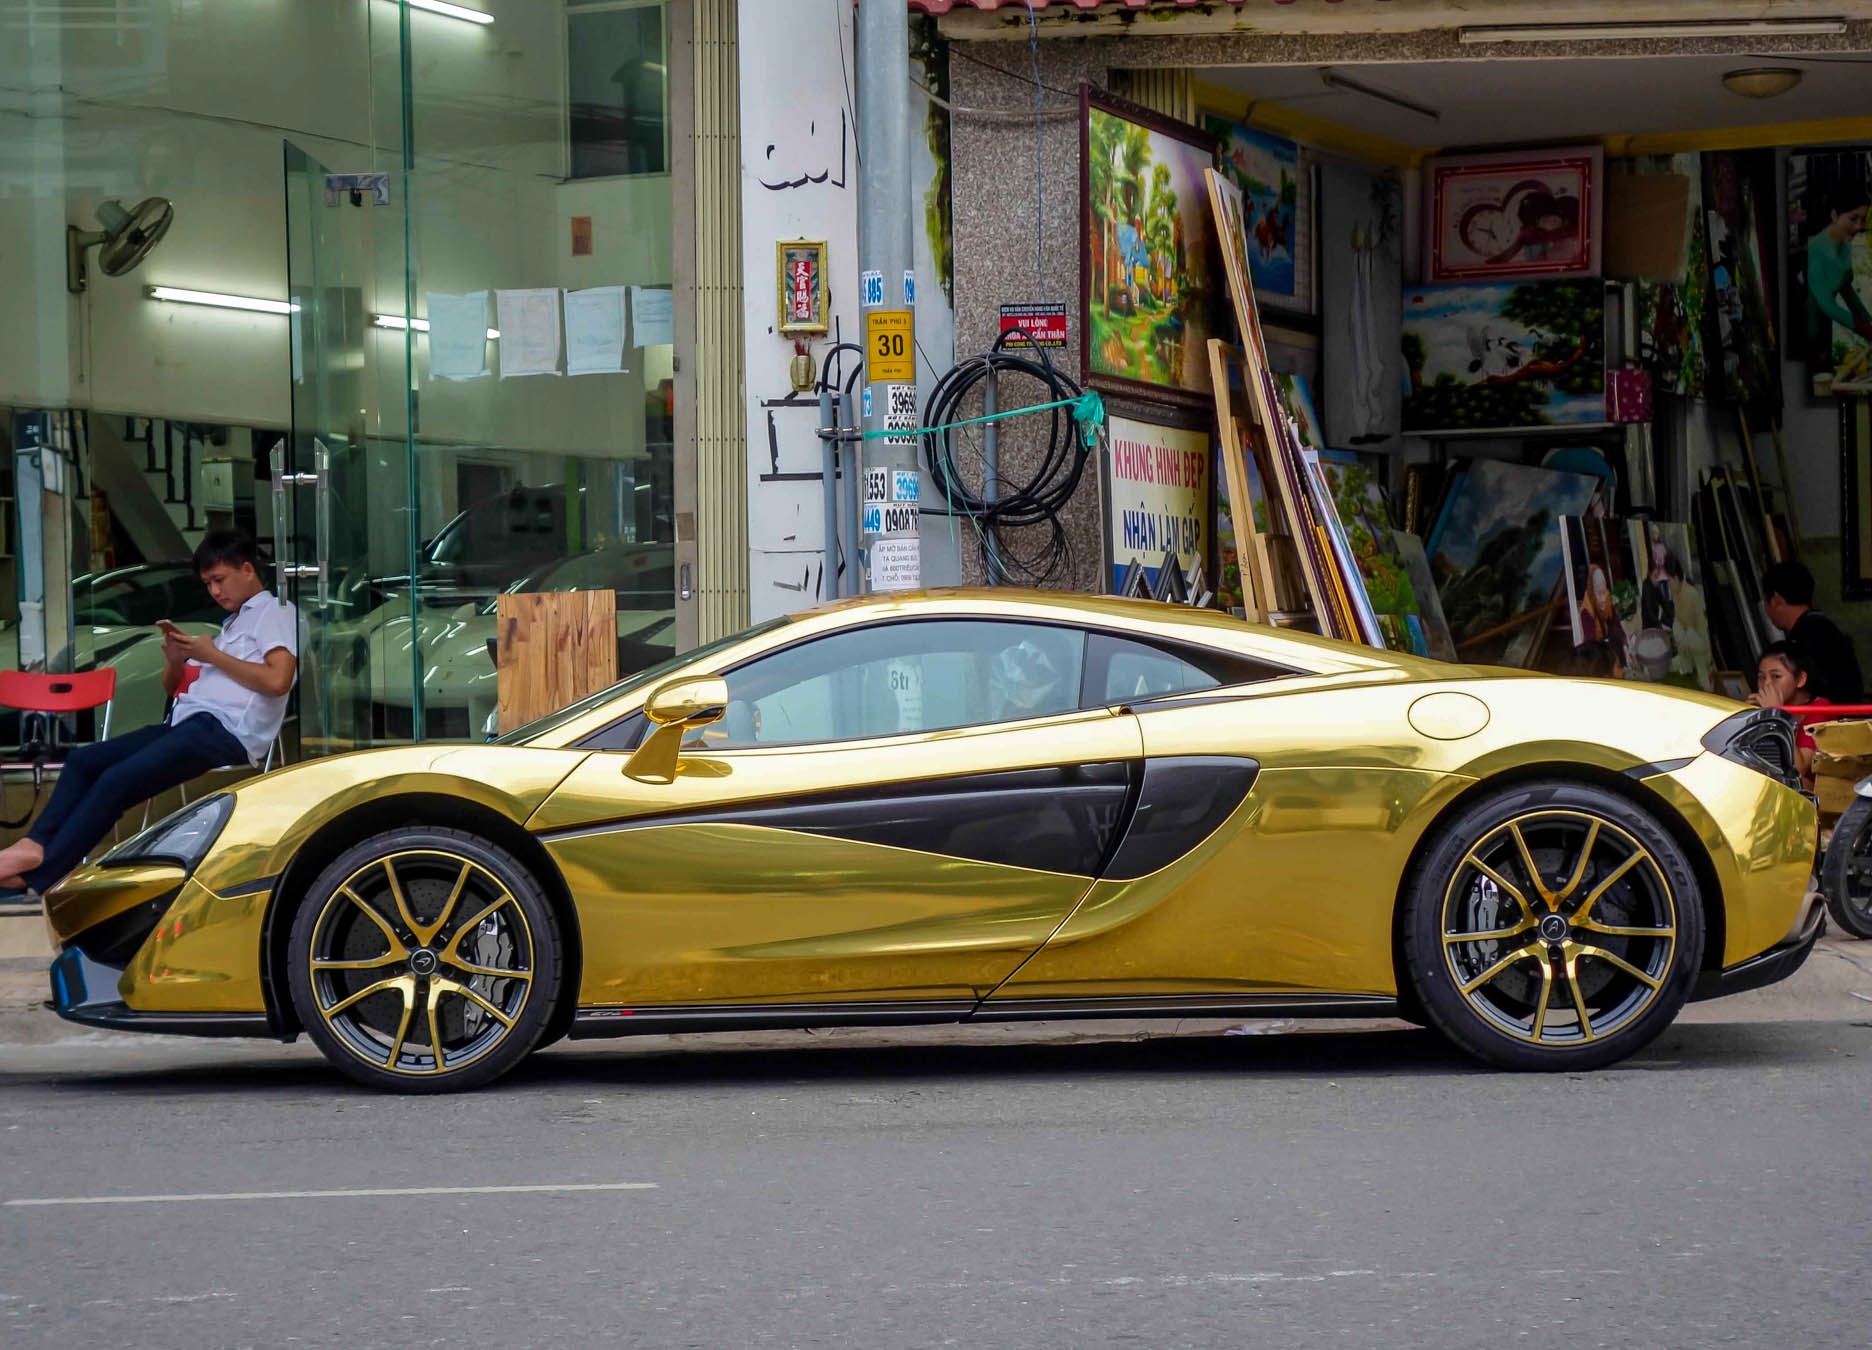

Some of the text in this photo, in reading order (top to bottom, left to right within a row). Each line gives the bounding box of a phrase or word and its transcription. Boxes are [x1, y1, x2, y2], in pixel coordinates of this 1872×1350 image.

[1018, 319, 1029, 327] VUI
[878, 335, 904, 356] 30
[1114, 438, 1204, 498] KHUNG HÌNH ĐẸP
[1123, 501, 1200, 559] NHẬN LÀM GẤP
